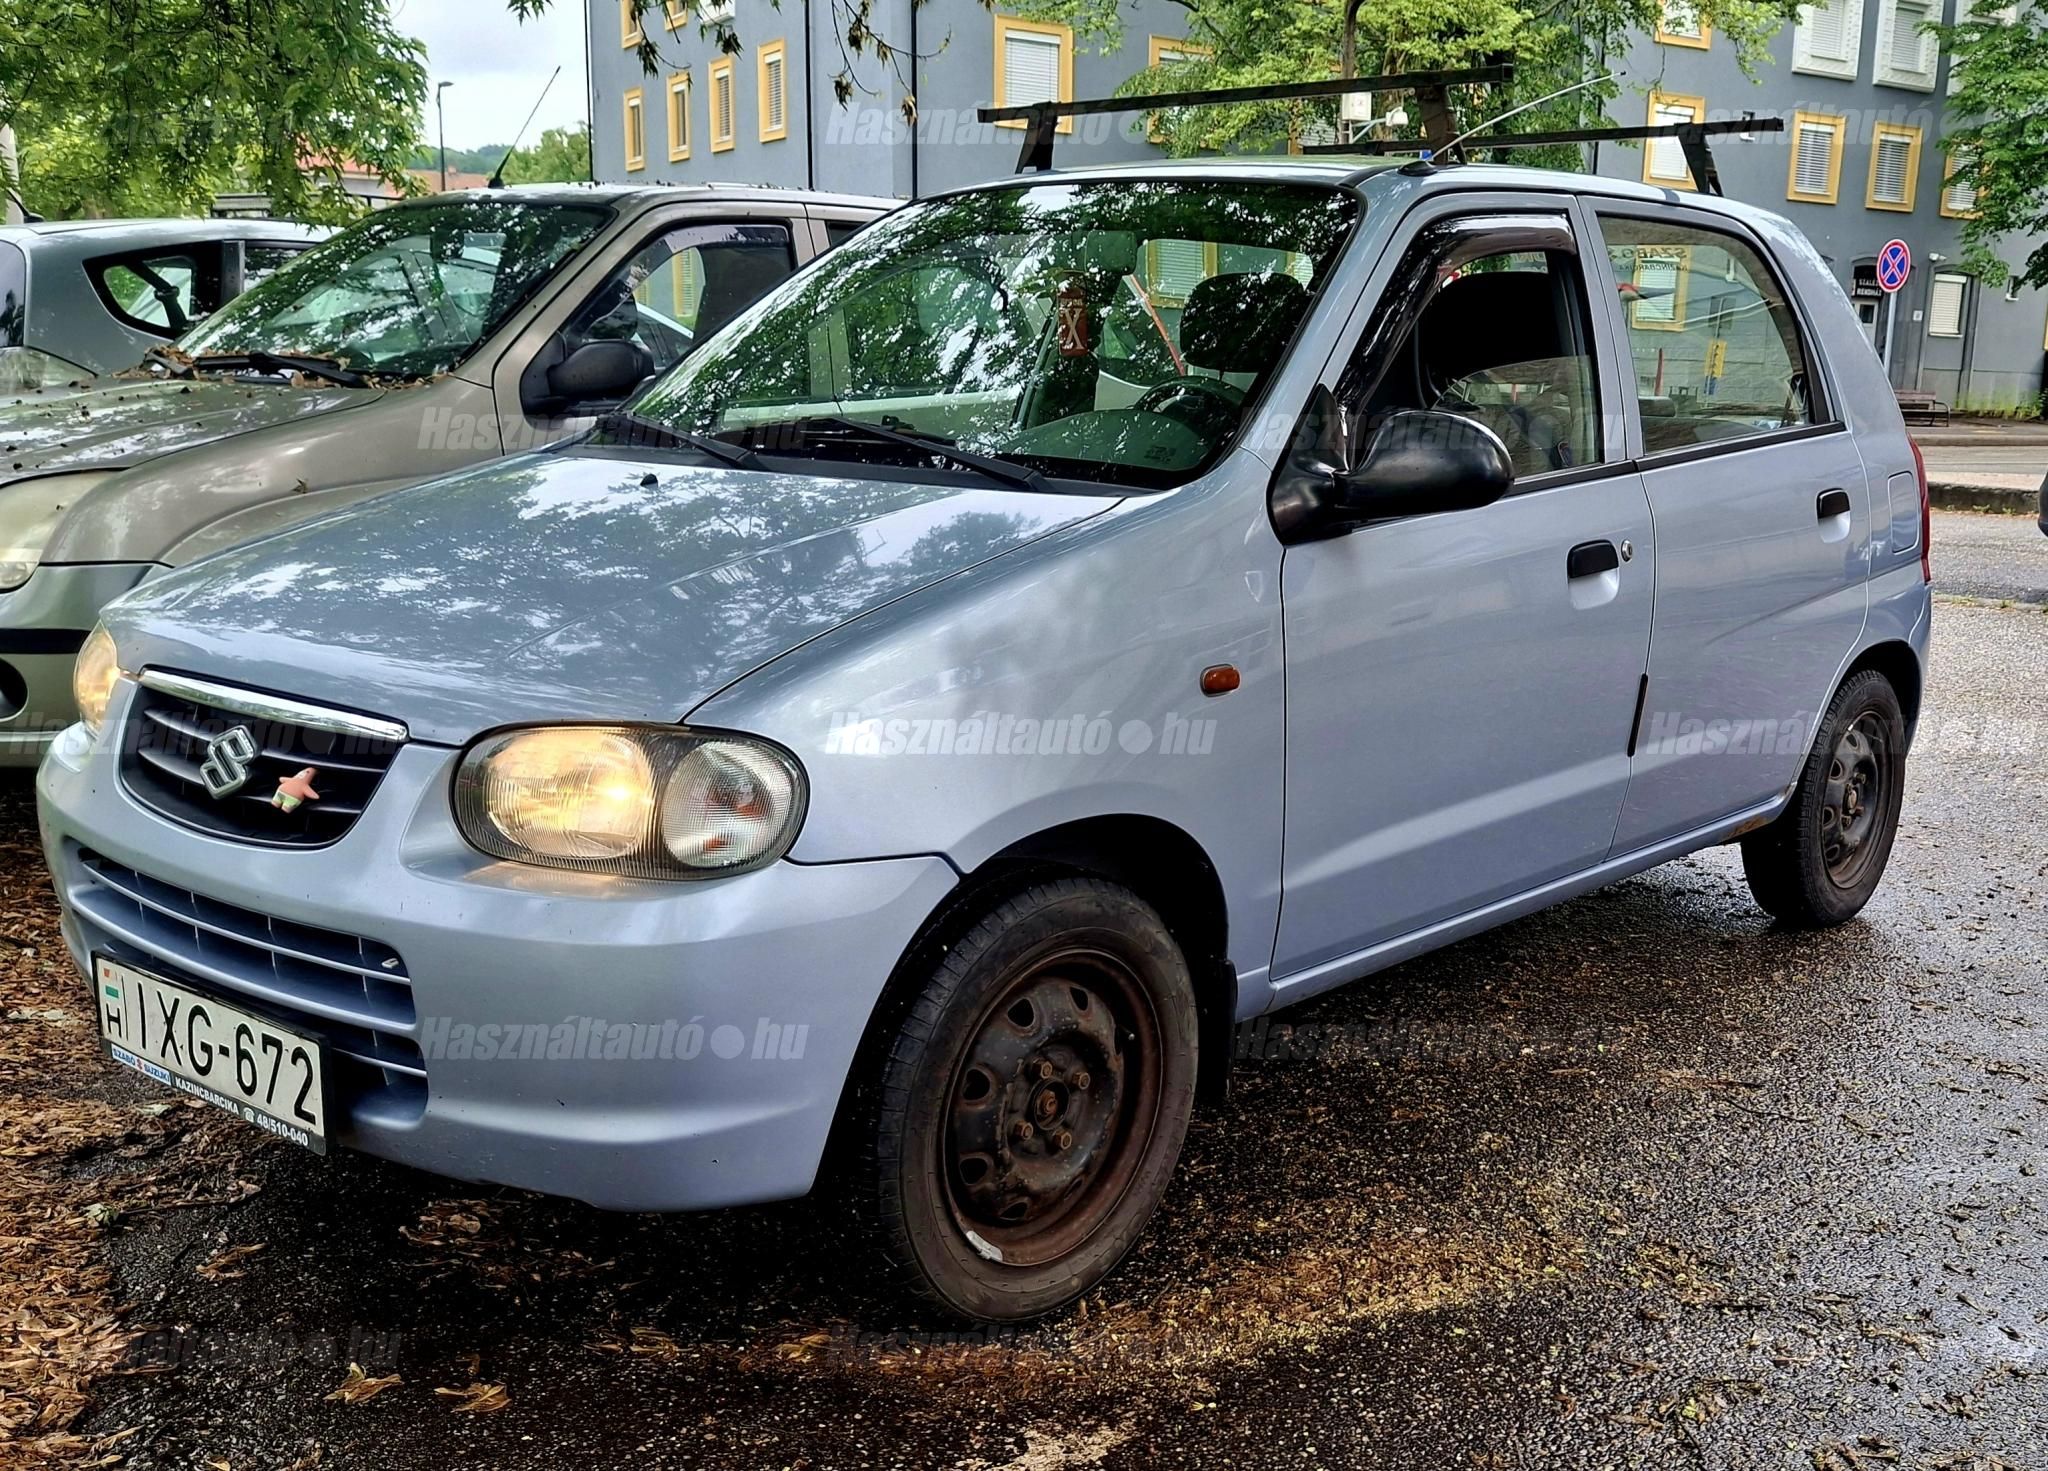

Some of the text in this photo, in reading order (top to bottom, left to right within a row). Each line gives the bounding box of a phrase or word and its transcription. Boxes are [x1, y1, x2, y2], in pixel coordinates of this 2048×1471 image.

[138, 982, 317, 1126] IXG-672
[175, 1076, 239, 1115] KAZINCBARCIKA
[256, 1113, 309, 1147] 48/510-040
